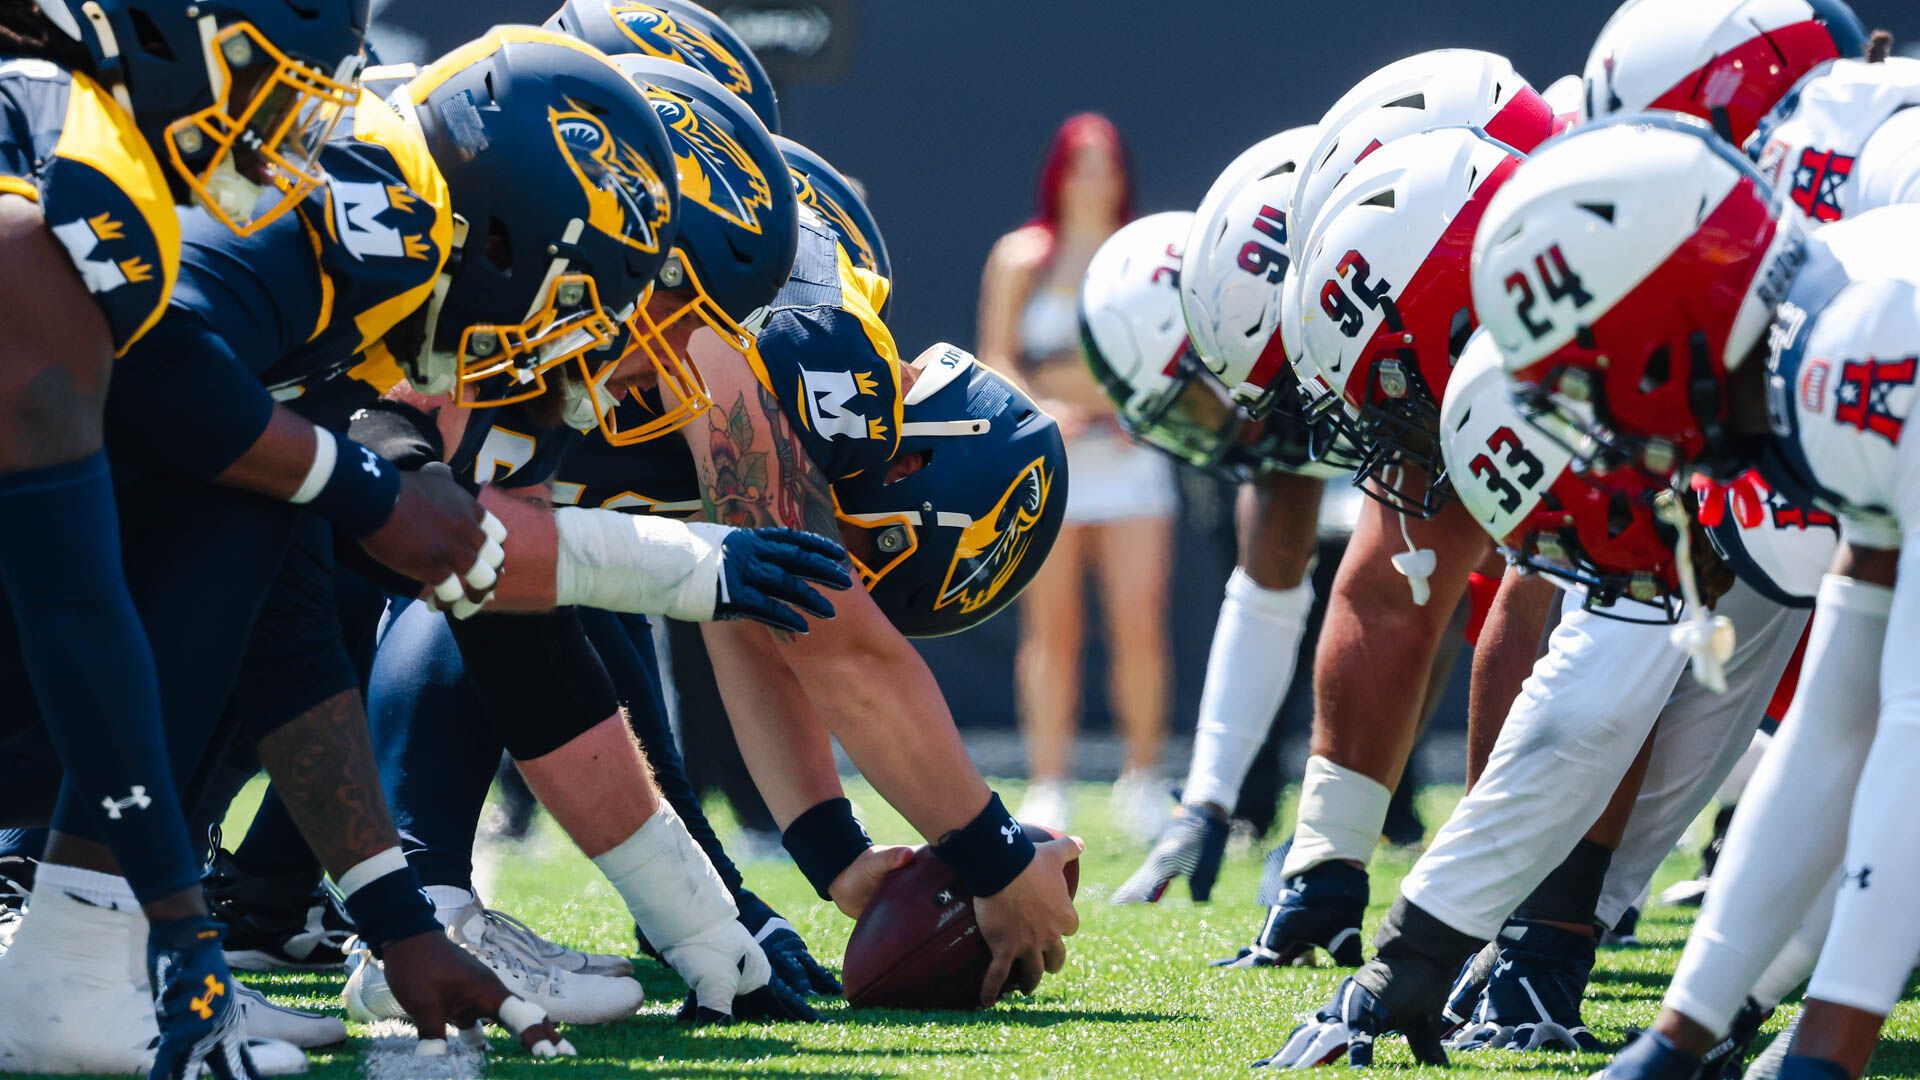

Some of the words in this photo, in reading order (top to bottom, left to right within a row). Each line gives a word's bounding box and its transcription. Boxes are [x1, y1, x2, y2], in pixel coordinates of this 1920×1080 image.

[1320, 249, 1391, 337] 92
[1504, 244, 1595, 339] 24
[798, 361, 868, 442] M
[1468, 426, 1544, 514] 33
